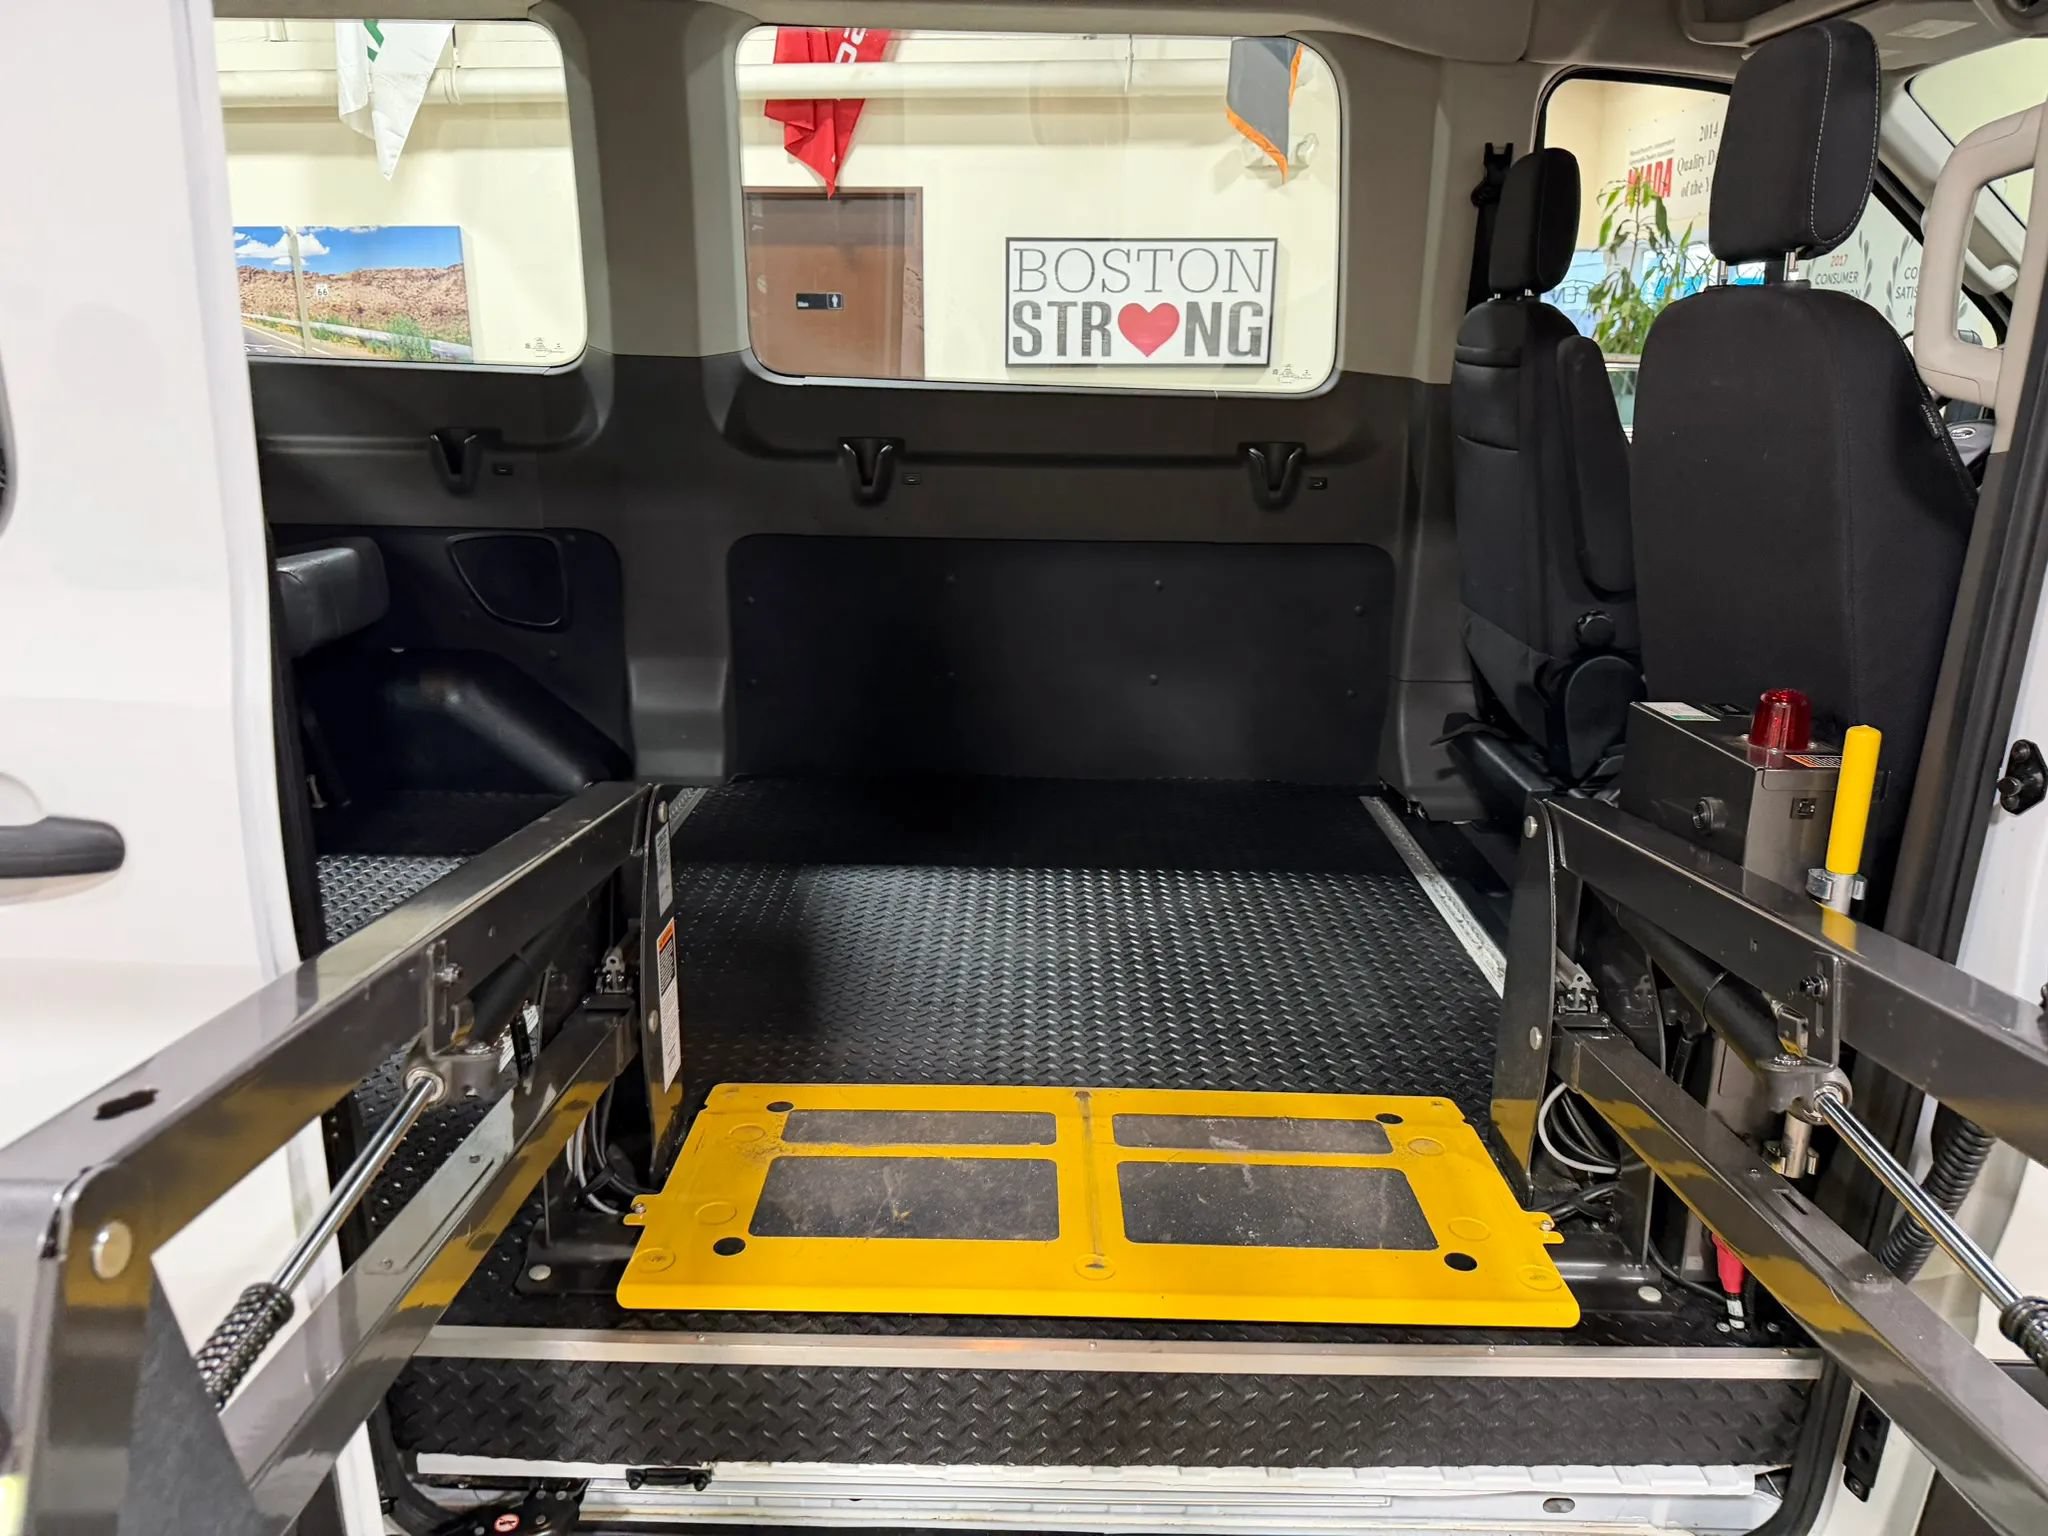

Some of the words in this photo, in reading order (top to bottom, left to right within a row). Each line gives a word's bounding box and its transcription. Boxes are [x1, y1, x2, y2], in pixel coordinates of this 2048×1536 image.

[1699, 121, 1719, 142] 2014
[1677, 154, 1705, 176] Quality
[1680, 180, 1690, 198] of
[1690, 179, 1703, 196] the
[1012, 248, 1270, 293] BOSTON
[1830, 254, 1849, 268] 2017
[1814, 271, 1860, 286] CONSUMER
